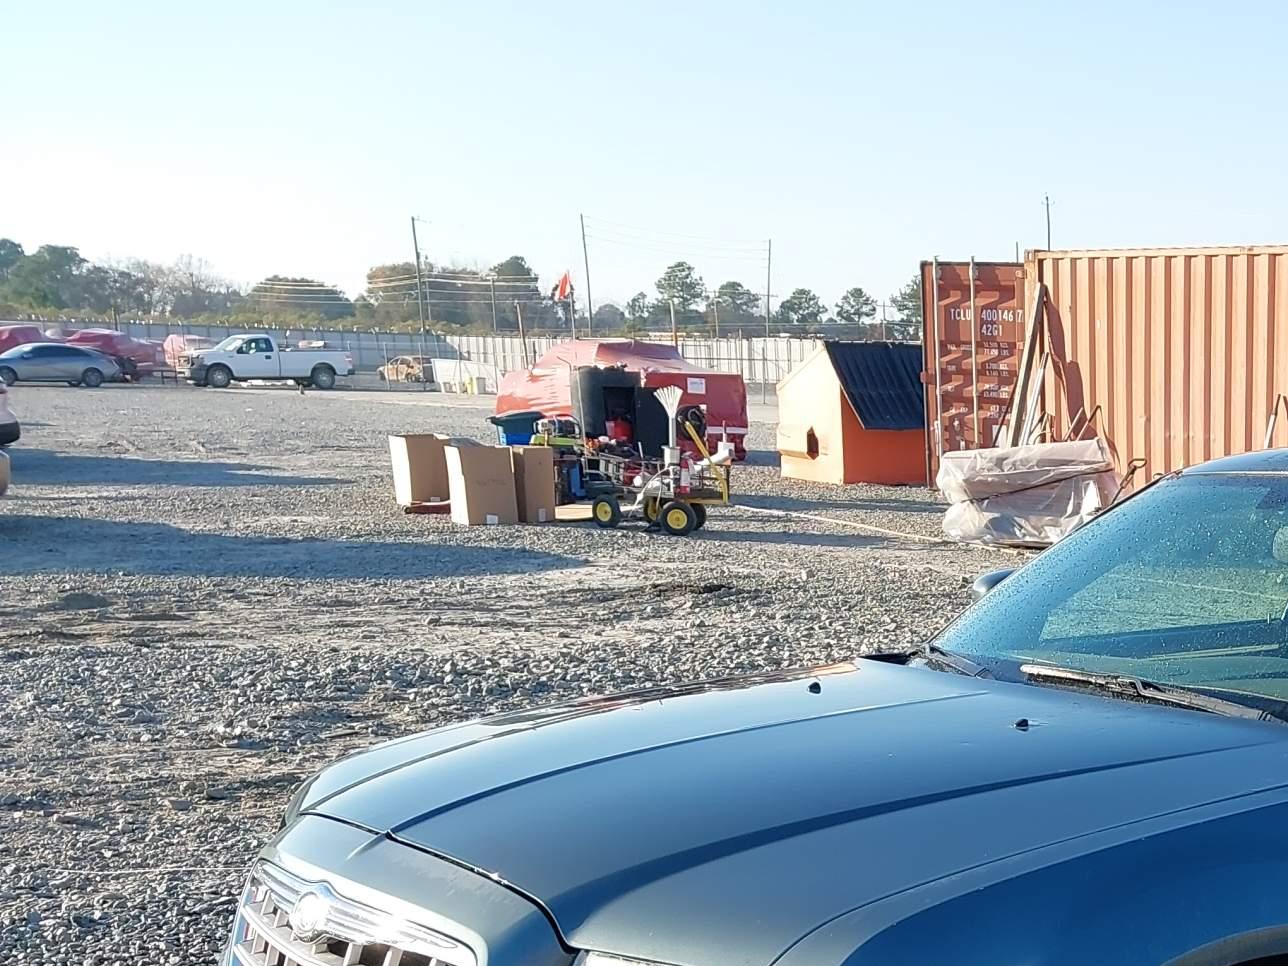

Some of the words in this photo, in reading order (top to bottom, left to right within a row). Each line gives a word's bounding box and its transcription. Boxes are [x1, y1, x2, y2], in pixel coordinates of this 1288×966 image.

[950, 309, 972, 321] TCLU
[981, 309, 1014, 322] 400146
[981, 324, 1003, 337] 42G1
